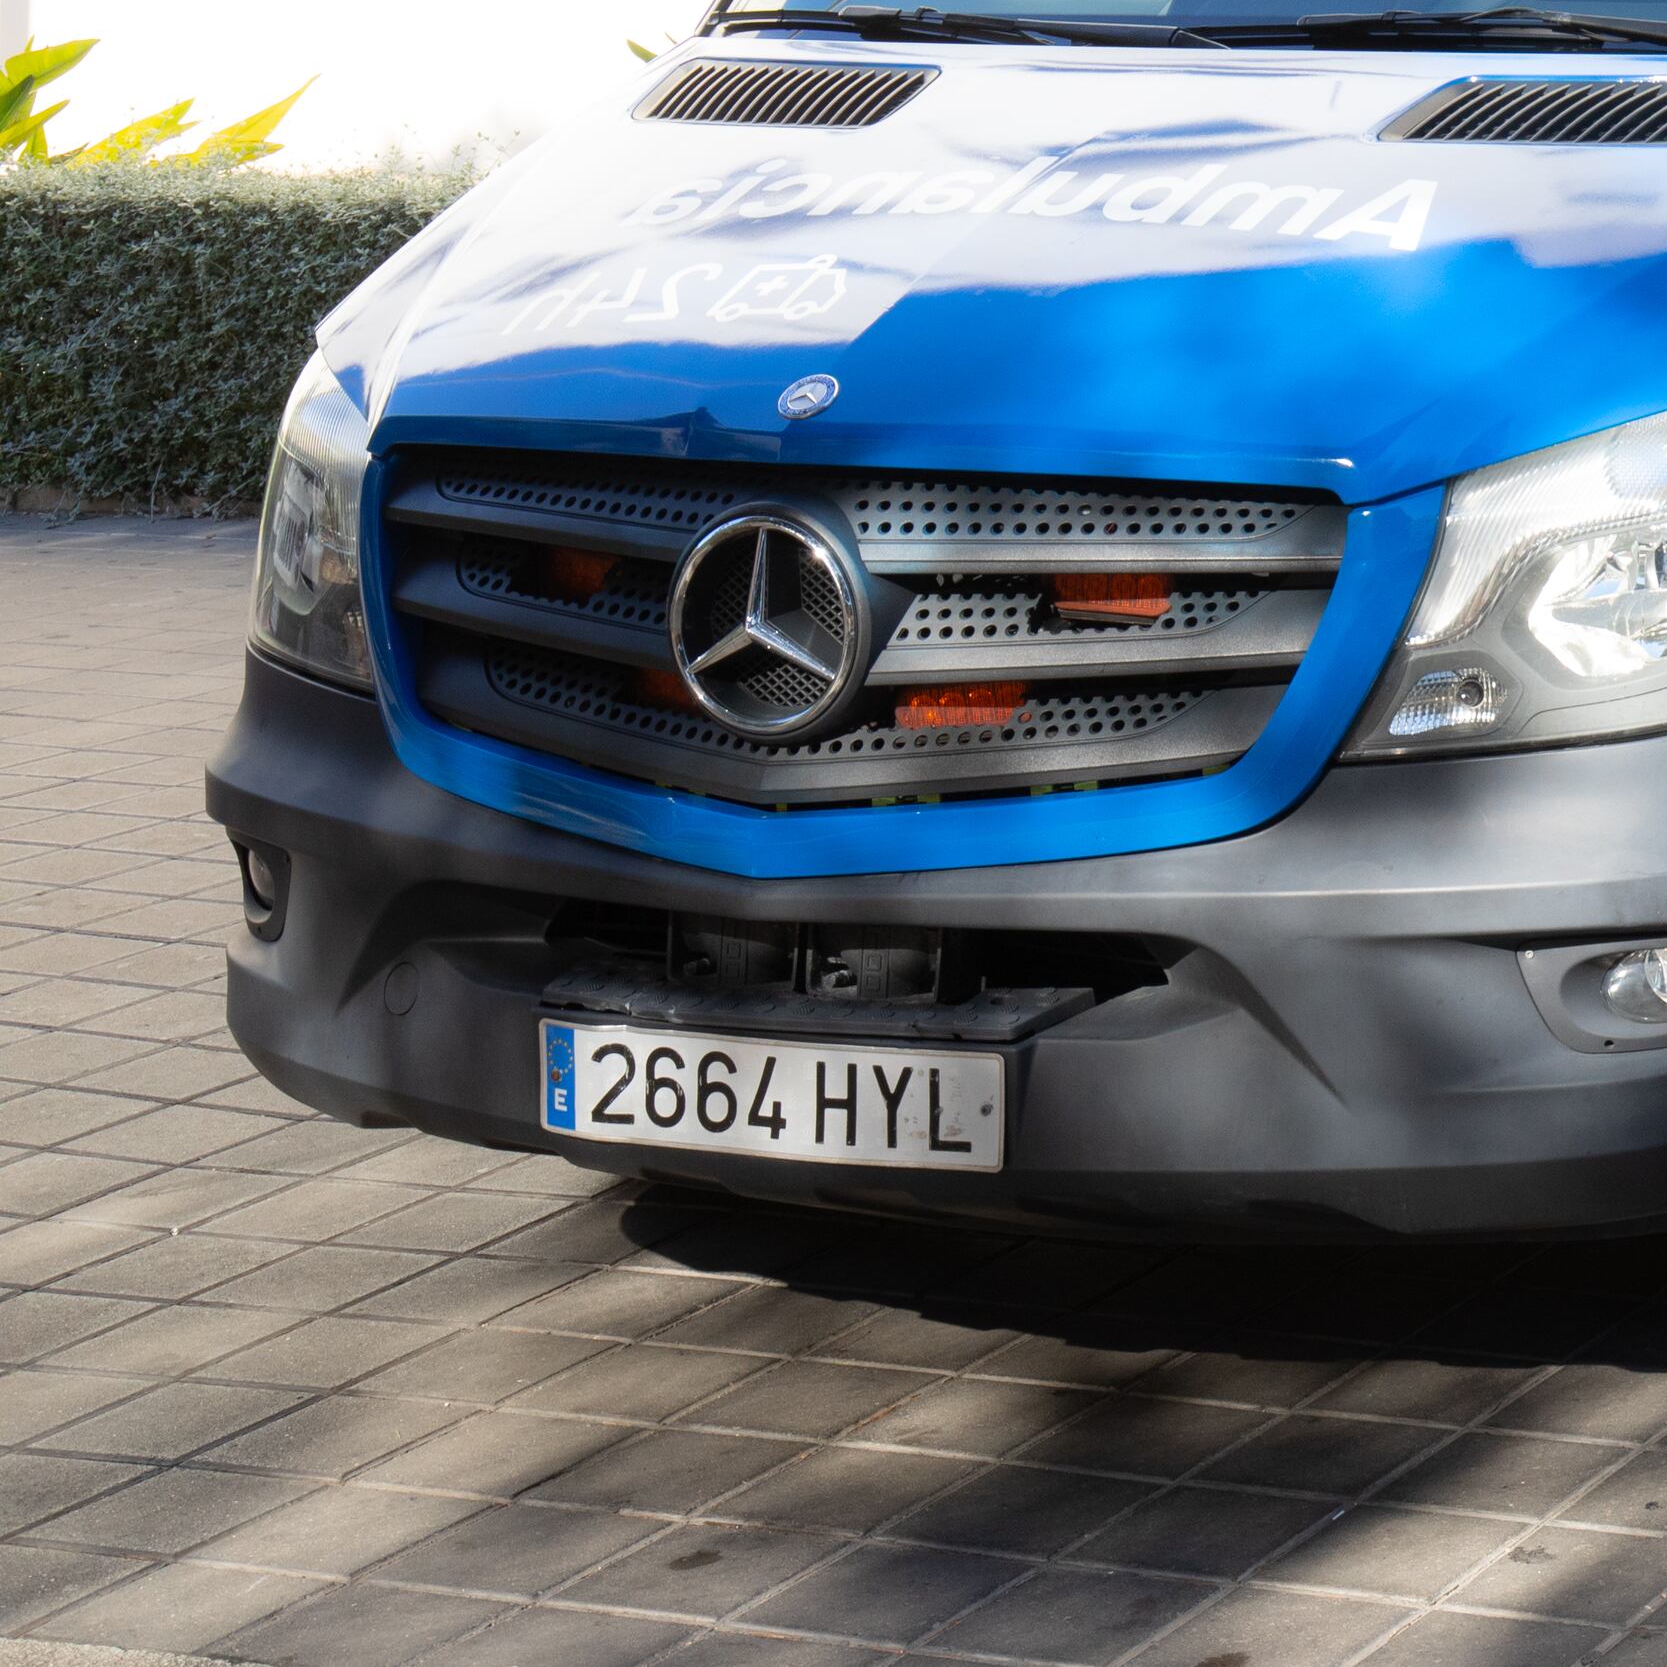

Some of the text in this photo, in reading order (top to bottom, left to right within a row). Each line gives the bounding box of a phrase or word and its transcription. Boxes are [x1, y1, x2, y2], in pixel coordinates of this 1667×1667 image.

[554, 1089, 567, 1112] E
[590, 1042, 972, 1153] 2664 HYL
